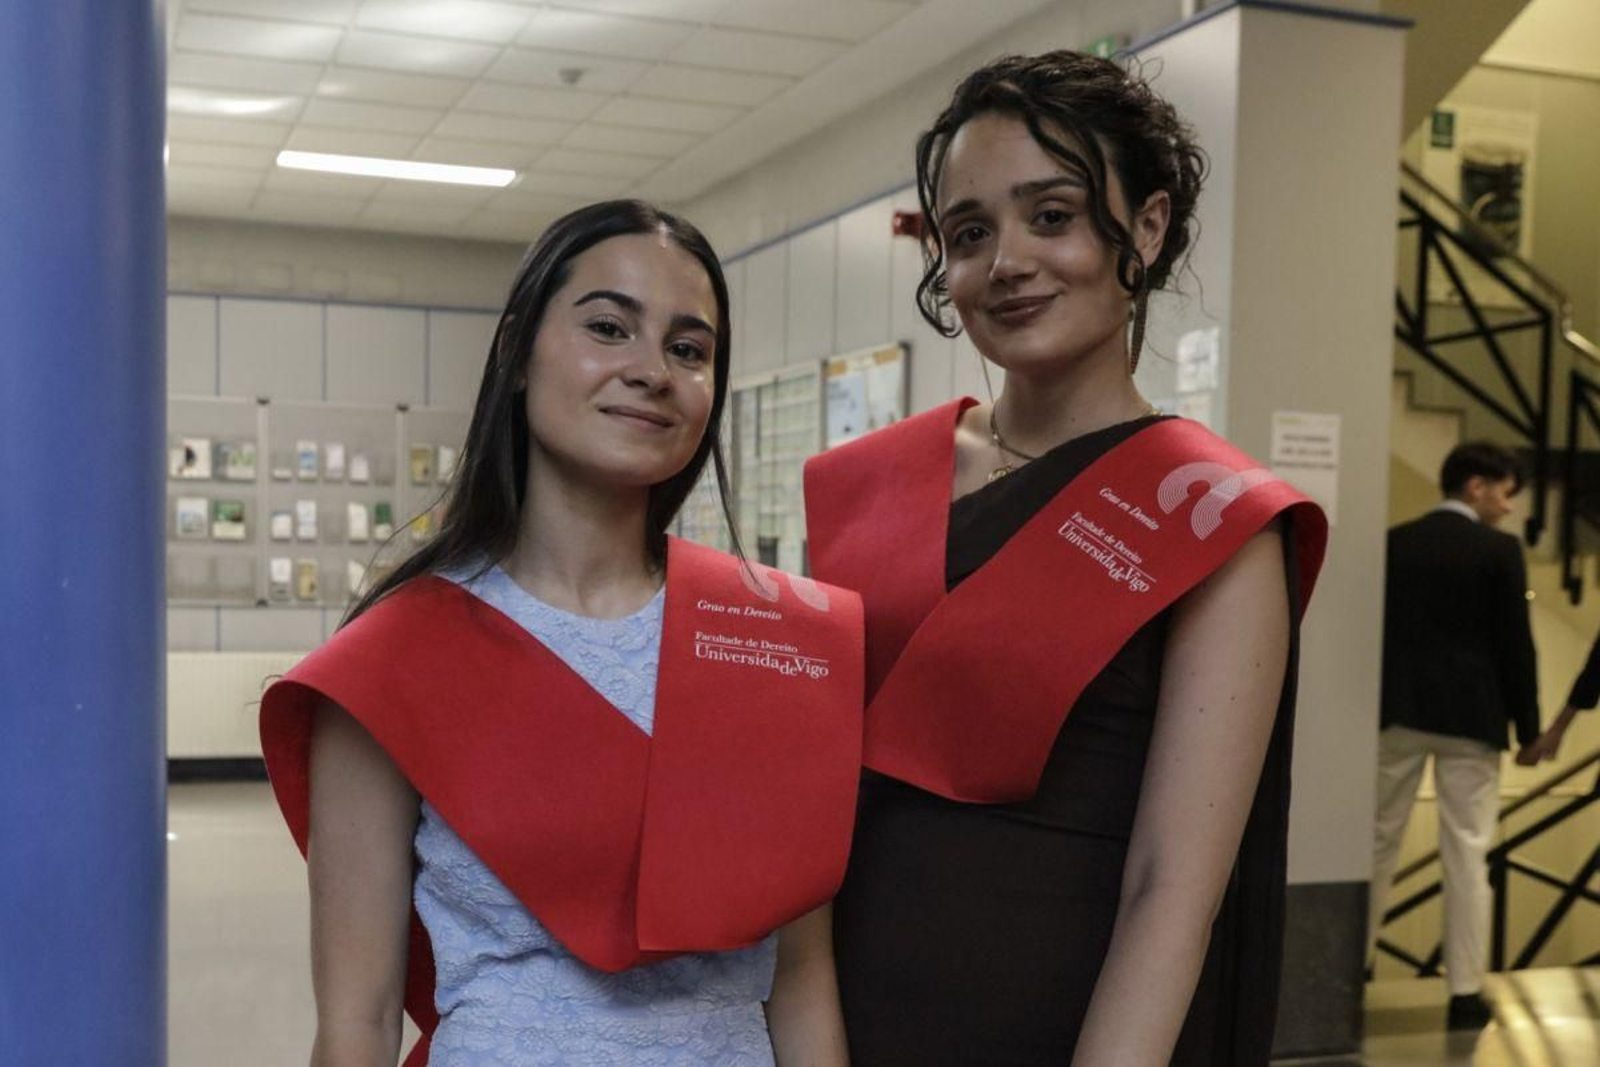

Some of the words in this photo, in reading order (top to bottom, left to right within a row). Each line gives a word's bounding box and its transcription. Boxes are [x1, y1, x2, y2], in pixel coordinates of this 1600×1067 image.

[1104, 533, 1116, 544] de
[697, 599, 725, 613] Grao
[727, 605, 741, 615] en
[744, 606, 782, 620] Dereito
[695, 632, 744, 645] Facultade
[745, 638, 758, 648] de
[761, 640, 798, 653] Dereito
